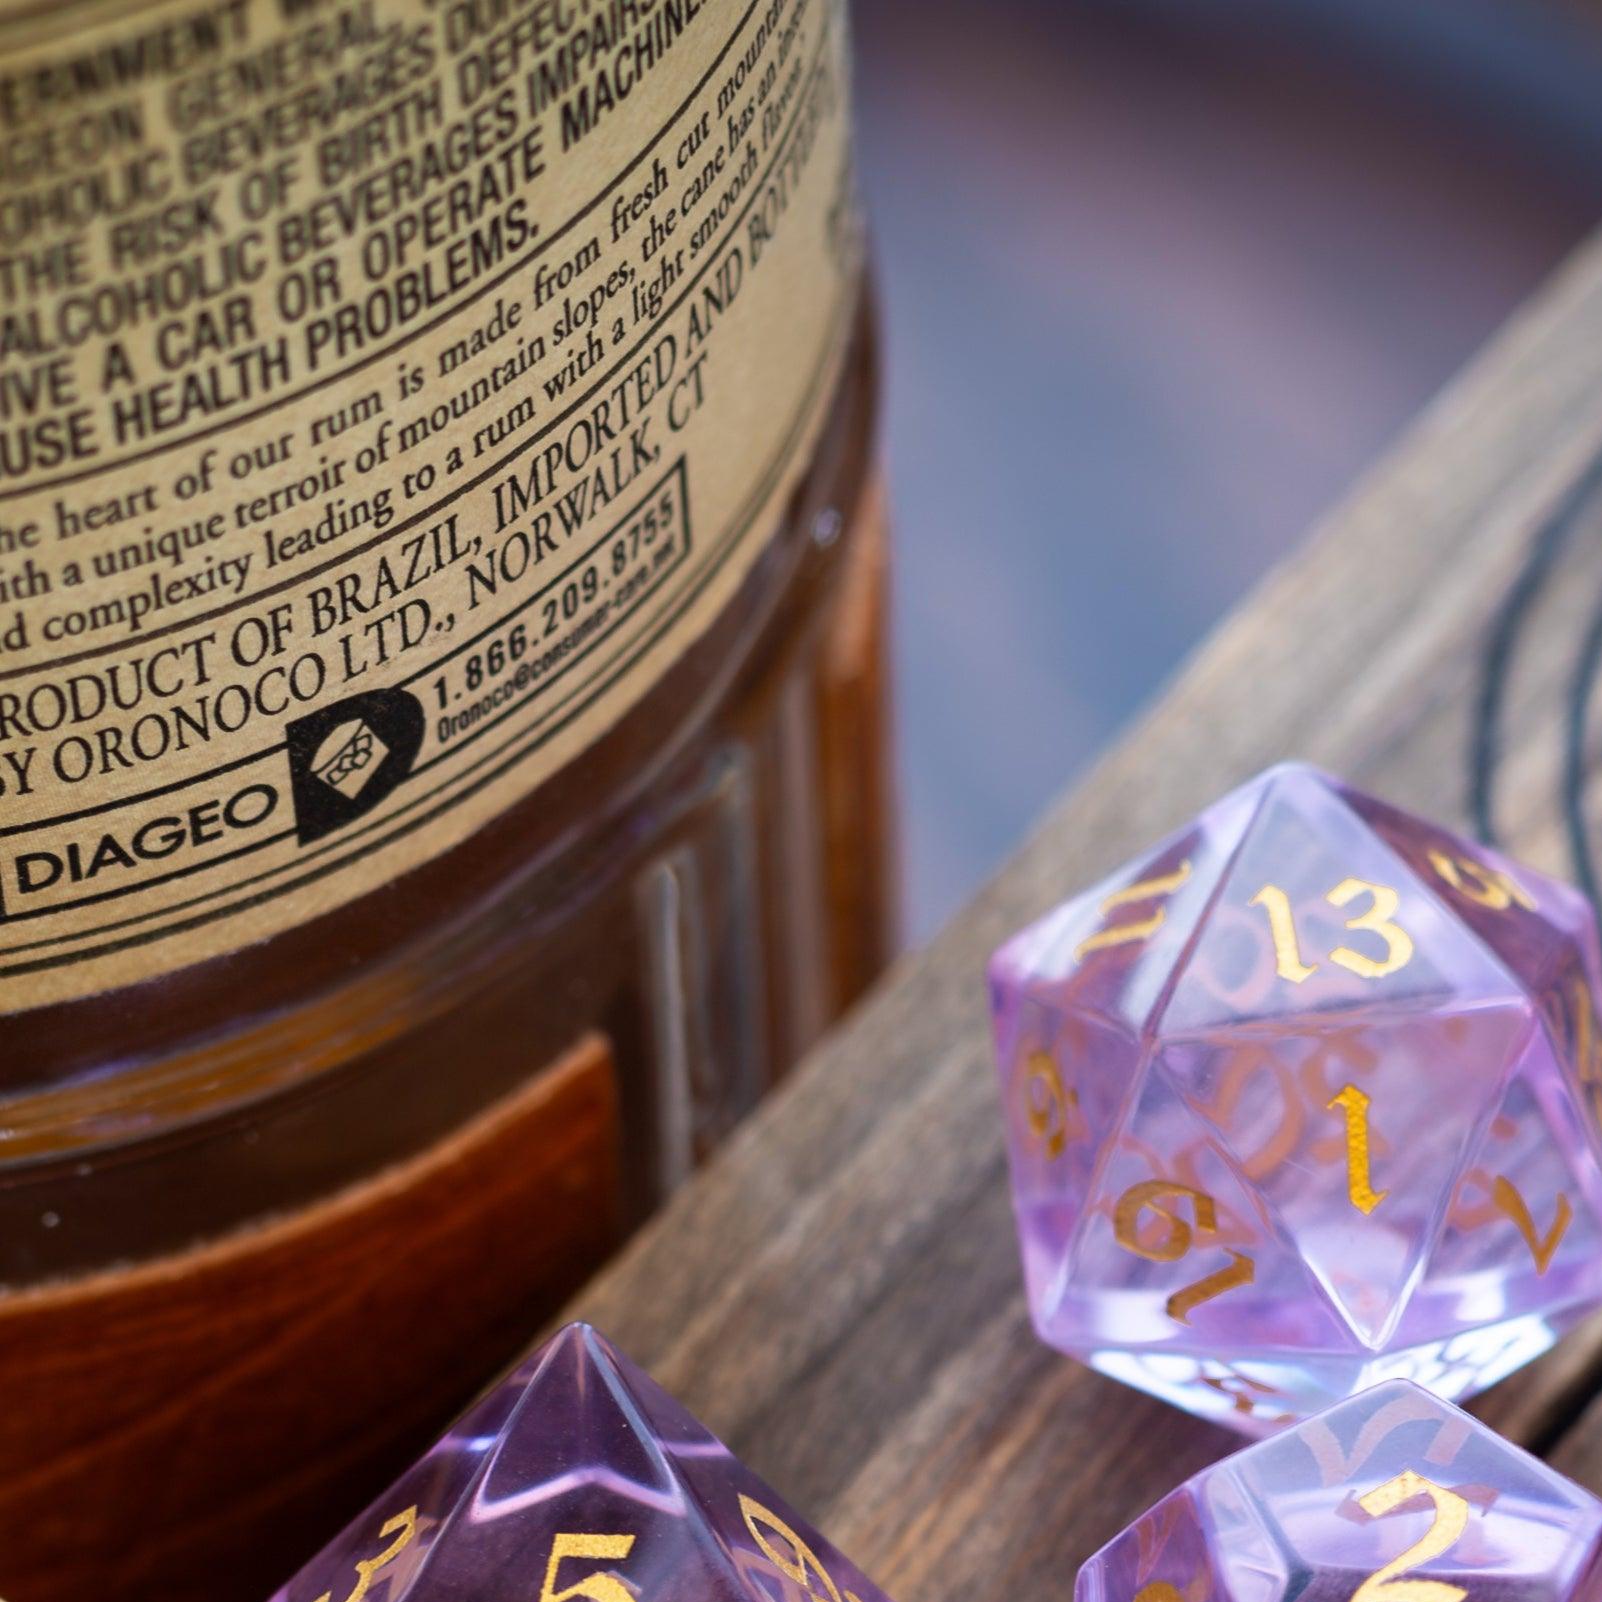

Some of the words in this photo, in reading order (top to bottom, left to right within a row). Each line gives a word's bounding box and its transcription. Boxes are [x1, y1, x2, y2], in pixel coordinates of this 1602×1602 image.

[0, 230, 268, 362] ALCOHOLIC
[276, 88, 518, 266] BEVERAGES
[101, 340, 136, 395] A
[156, 296, 256, 372] CAR
[277, 256, 342, 324] OR
[362, 126, 547, 284] OPERATE
[559, 0, 707, 153] MACHINE
[109, 190, 223, 272] RISK
[239, 154, 300, 222] OF
[317, 78, 442, 188] BIRTH
[42, 552, 255, 642] complexity
[263, 487, 396, 569] leading
[402, 464, 437, 500] to
[446, 446, 465, 475] a
[473, 395, 538, 458] rum
[542, 330, 607, 404] with
[611, 317, 627, 346] a
[631, 247, 686, 325] light
[689, 140, 759, 261] smooth
[54, 485, 160, 541] heart
[173, 447, 218, 501] of
[229, 432, 295, 480] our
[309, 390, 385, 447] rum
[397, 362, 425, 401] is
[437, 297, 523, 379] made
[533, 235, 603, 311] from
[610, 156, 670, 245] fresh
[676, 110, 711, 171] cut
[61, 561, 84, 587] a
[92, 513, 226, 580] unique
[234, 456, 348, 529] terroir
[354, 420, 394, 474] of
[398, 335, 547, 454] mountain
[551, 259, 636, 347] slopes,
[641, 207, 678, 263] the
[680, 144, 726, 218] cane
[727, 97, 757, 157] has
[111, 334, 292, 446] HEALTH
[304, 197, 541, 372] PROBLEMS.
[231, 602, 293, 668] OF
[307, 513, 483, 638] BRAZIL,
[490, 333, 678, 534] IMPORTED
[685, 246, 744, 360] AND
[52, 650, 326, 783] ORONOCO
[464, 428, 661, 611] NORWALK,
[667, 348, 709, 433] CT
[432, 490, 675, 711] 1.866.209.8755
[14, 783, 279, 894] DIAGEO
[1249, 877, 1414, 984] 13
[1326, 1083, 1389, 1216] 1
